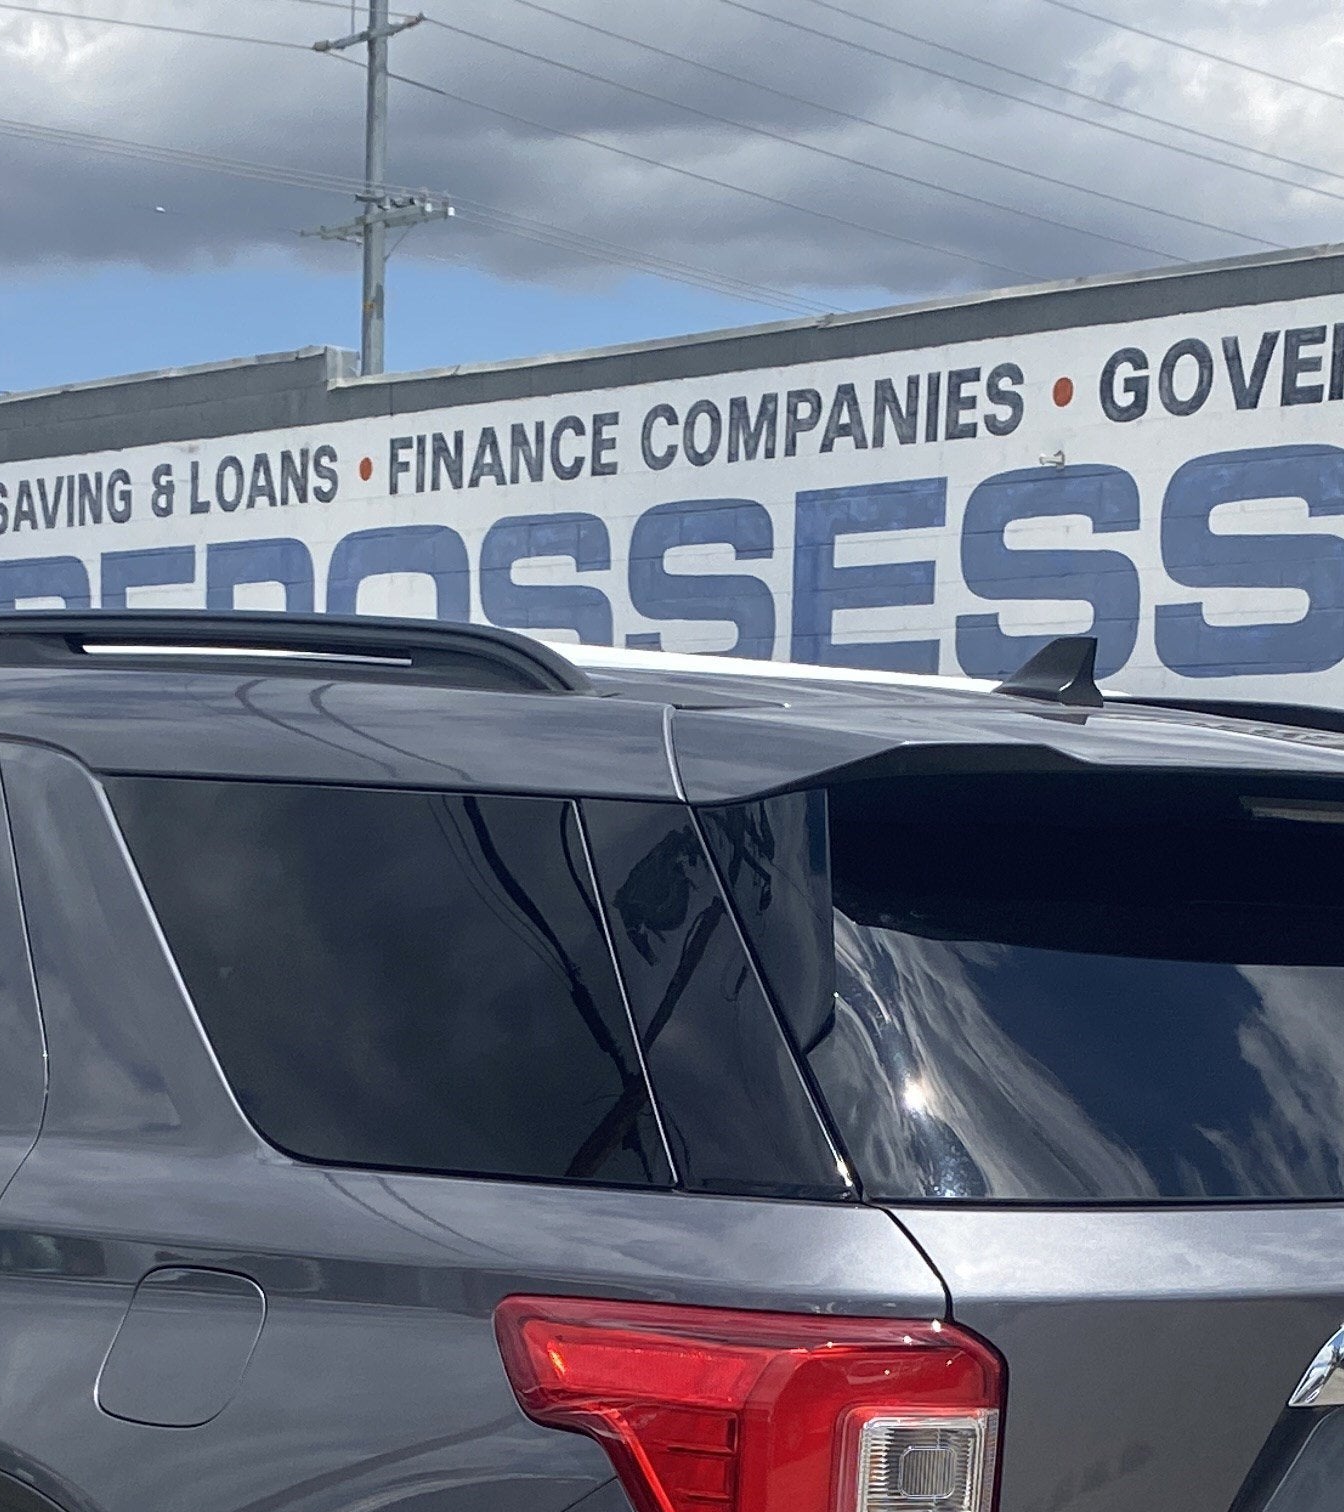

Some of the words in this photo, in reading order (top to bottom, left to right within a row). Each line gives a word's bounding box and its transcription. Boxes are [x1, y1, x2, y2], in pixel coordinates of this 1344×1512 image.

[152, 463, 175, 519] &
[190, 444, 339, 514] LOANS
[389, 411, 618, 495] FINANCE
[641, 362, 1025, 471] COMPANIES
